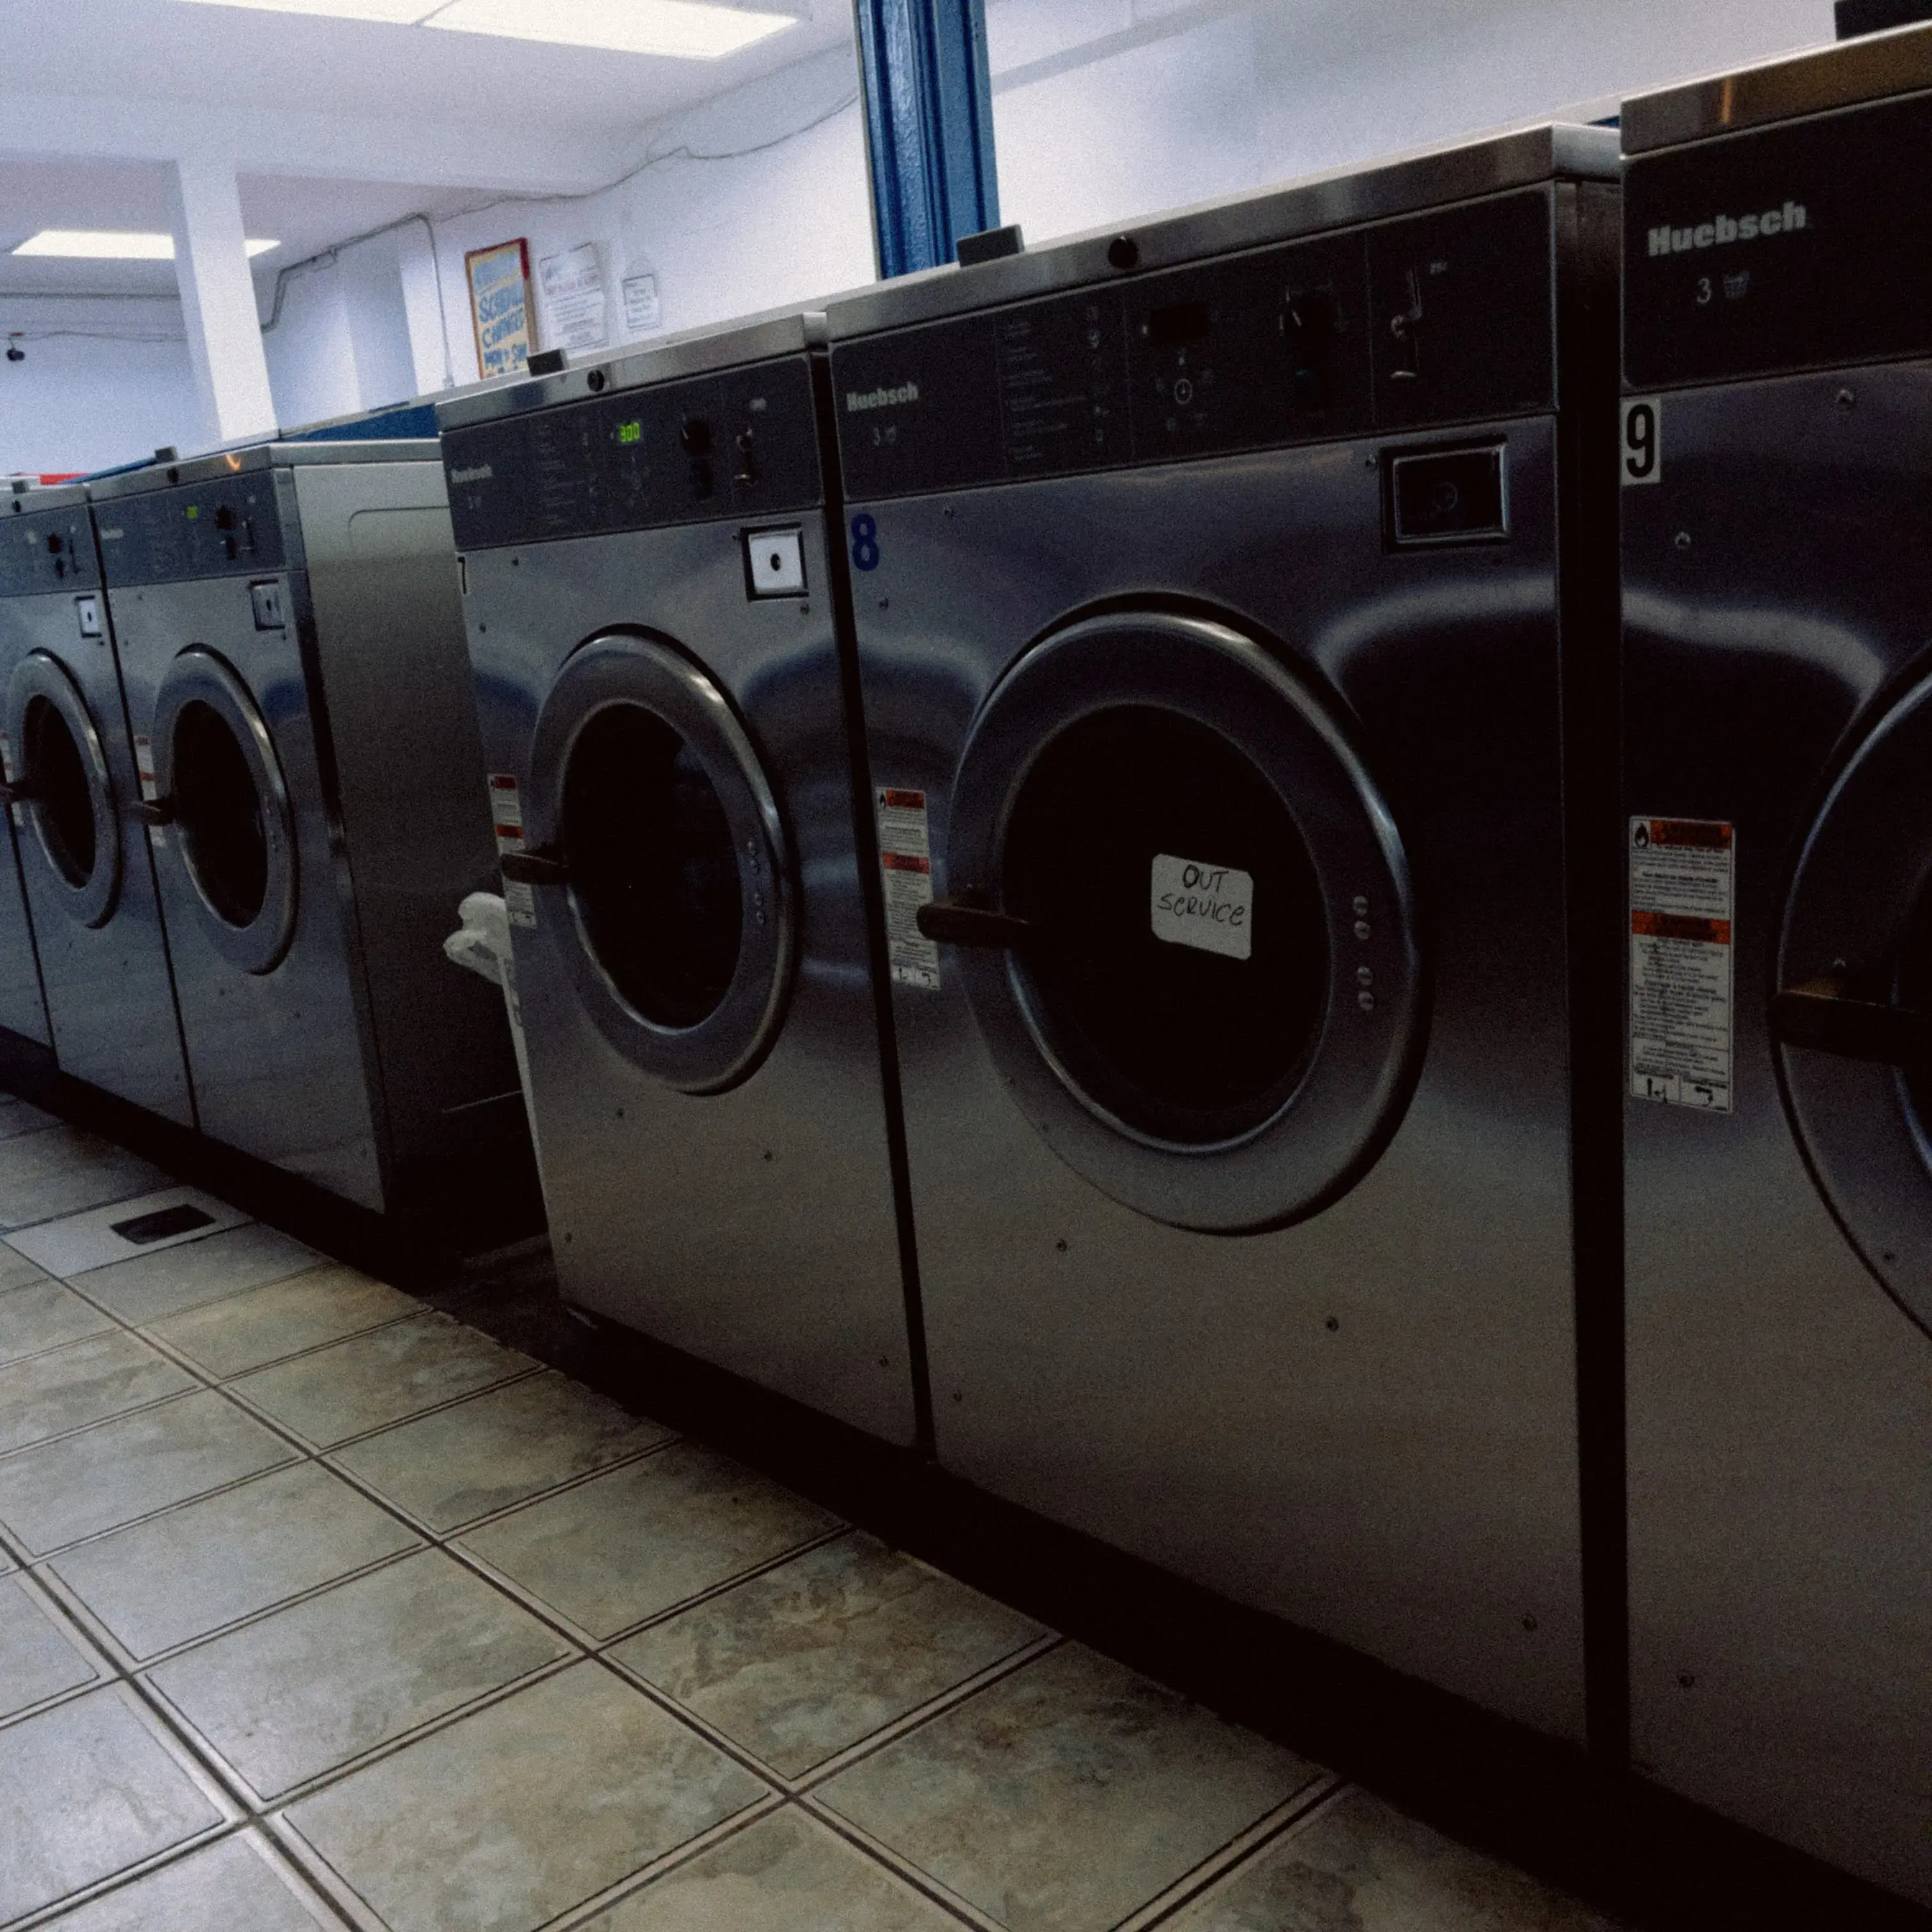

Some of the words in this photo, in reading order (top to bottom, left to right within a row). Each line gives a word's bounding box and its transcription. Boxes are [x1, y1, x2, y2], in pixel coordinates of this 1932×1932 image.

[1648, 200, 1807, 257] Huebsch
[846, 381, 919, 411] Huebsch
[1627, 404, 1655, 477] 9
[851, 513, 880, 571] 8
[1183, 864, 1229, 893] OUT
